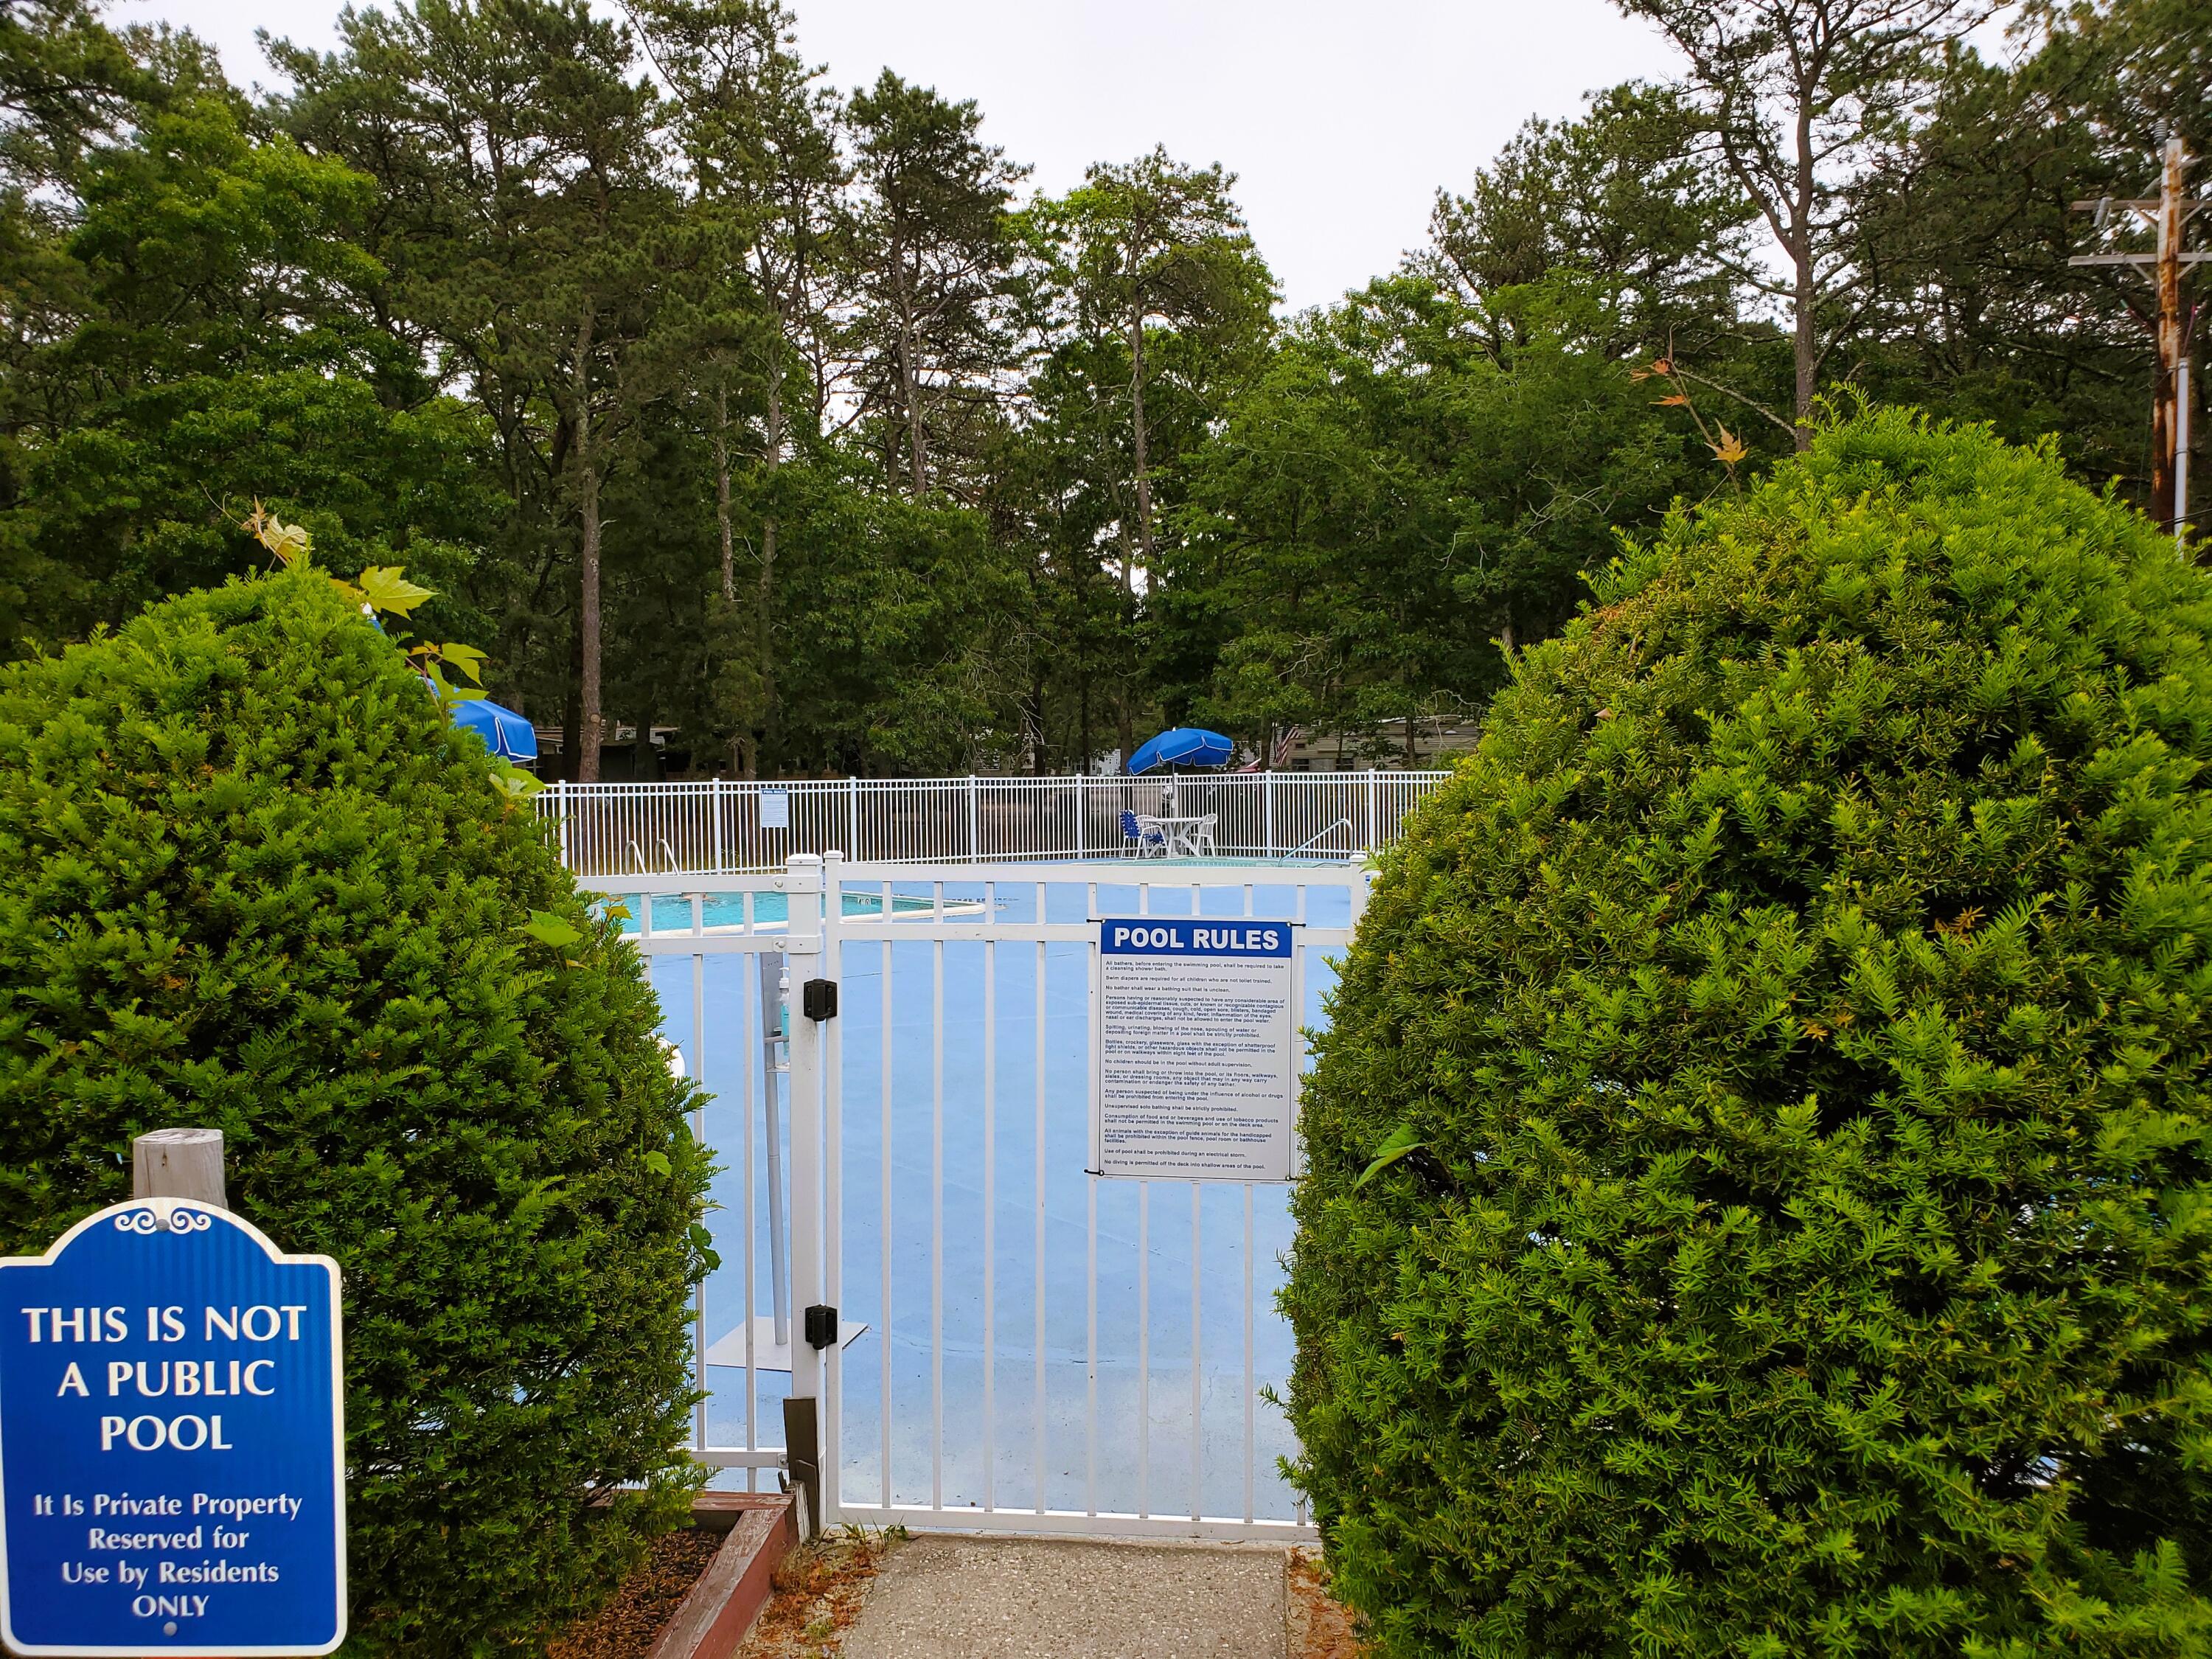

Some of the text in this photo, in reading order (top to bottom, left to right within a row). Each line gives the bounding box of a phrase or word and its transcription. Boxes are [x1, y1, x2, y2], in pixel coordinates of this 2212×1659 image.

[1114, 927, 1279, 950] POOL RULES
[21, 1305, 307, 1343] THIS IS NOT
[57, 1359, 275, 1397] A PUBLIC
[101, 1414, 232, 1451] POOL
[35, 1492, 302, 1522] It Is Private Property
[89, 1525, 249, 1549] Reserved for
[63, 1559, 279, 1590] Use by Residents
[132, 1595, 209, 1617] ONLY
